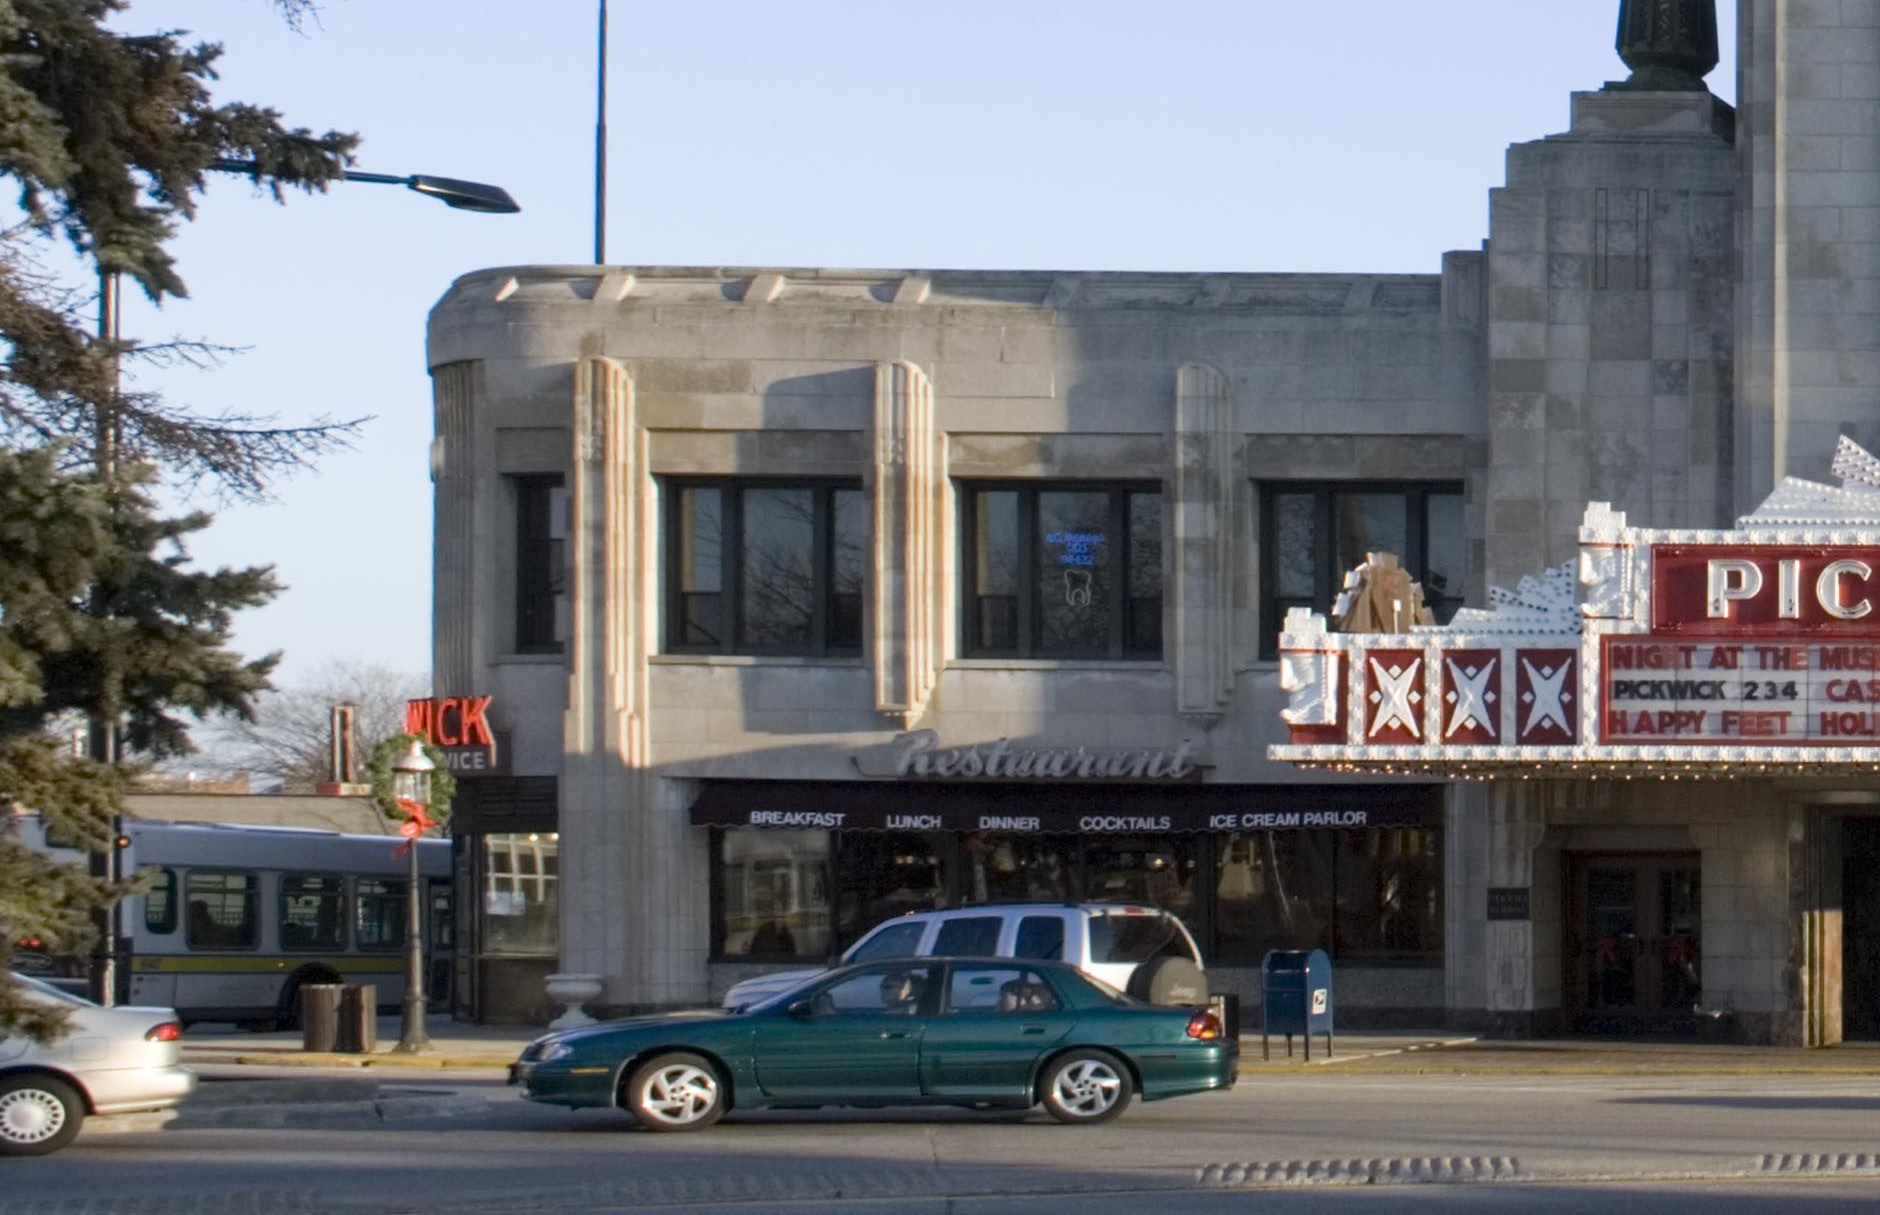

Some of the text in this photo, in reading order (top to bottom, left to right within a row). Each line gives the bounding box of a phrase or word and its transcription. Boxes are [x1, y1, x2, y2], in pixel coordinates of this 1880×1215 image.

[1709, 646, 1743, 669] AT
[1754, 646, 1808, 671] THE
[1614, 680, 1726, 701] PICKWICK
[1609, 709, 1706, 735] HAPPY
[1721, 710, 1792, 735] FEET
[897, 730, 1195, 777] Restaurant
[750, 810, 1367, 831] BREAKFAST LUNCH DINNER COCKTAILS ICE CREAM PARLOR
